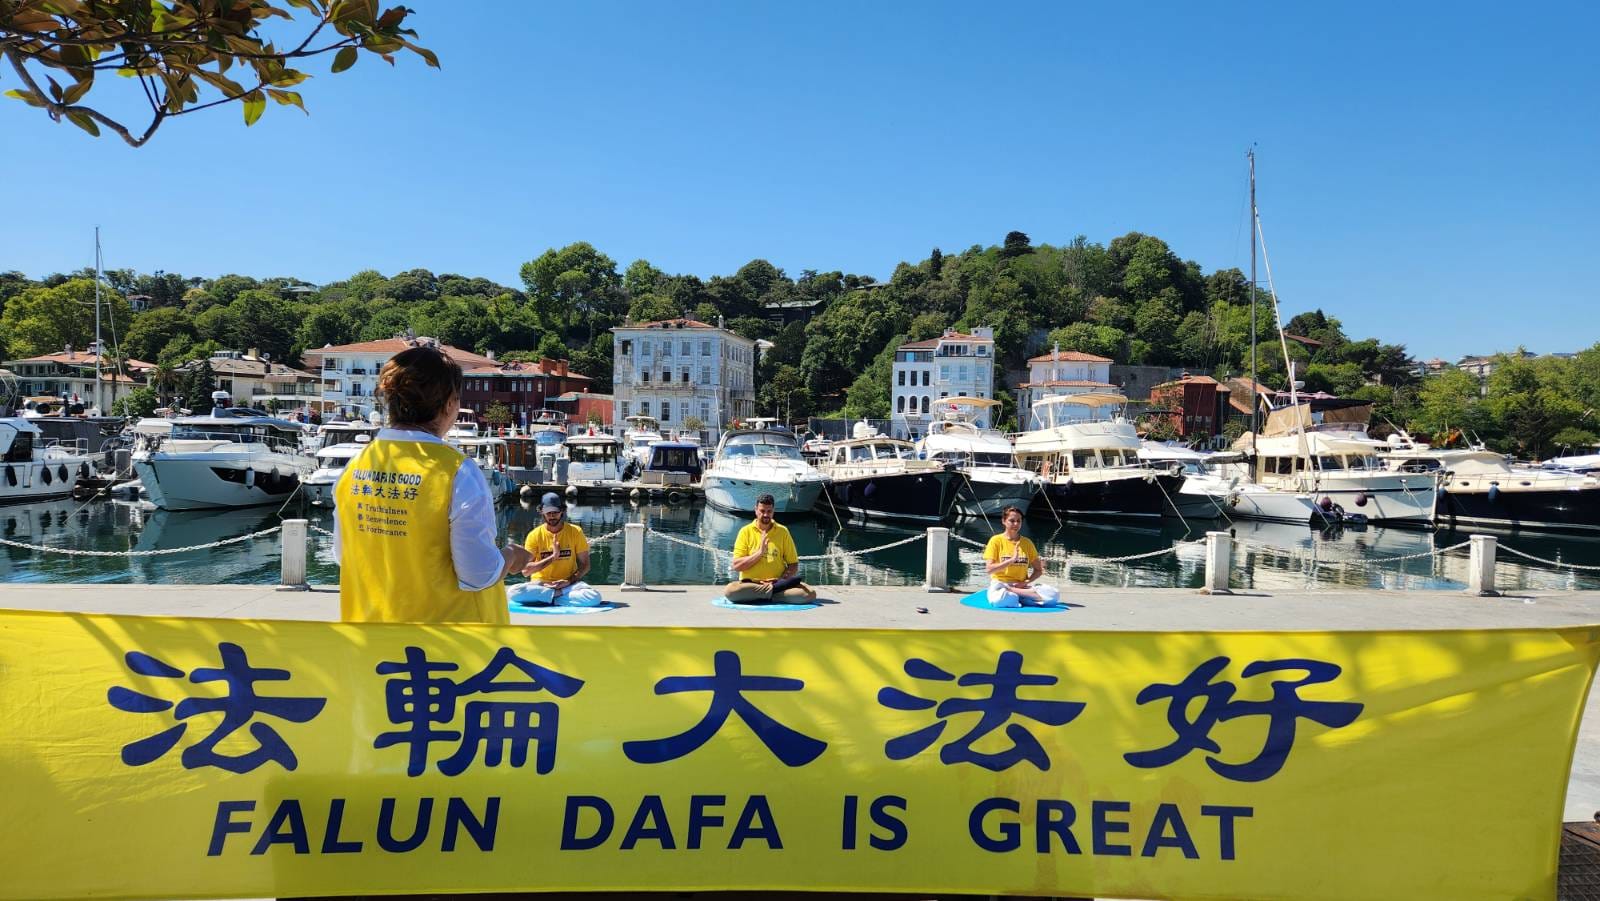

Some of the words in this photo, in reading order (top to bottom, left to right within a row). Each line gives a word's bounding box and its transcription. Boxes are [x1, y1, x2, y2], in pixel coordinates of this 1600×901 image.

[389, 472, 397, 484] IS
[398, 474, 422, 486] GOOD
[108, 642, 1363, 782] 法輪大法好
[208, 797, 500, 856] FALUN
[561, 795, 782, 850] DAFA
[843, 796, 908, 851] IS
[968, 798, 1253, 860] GREAT
